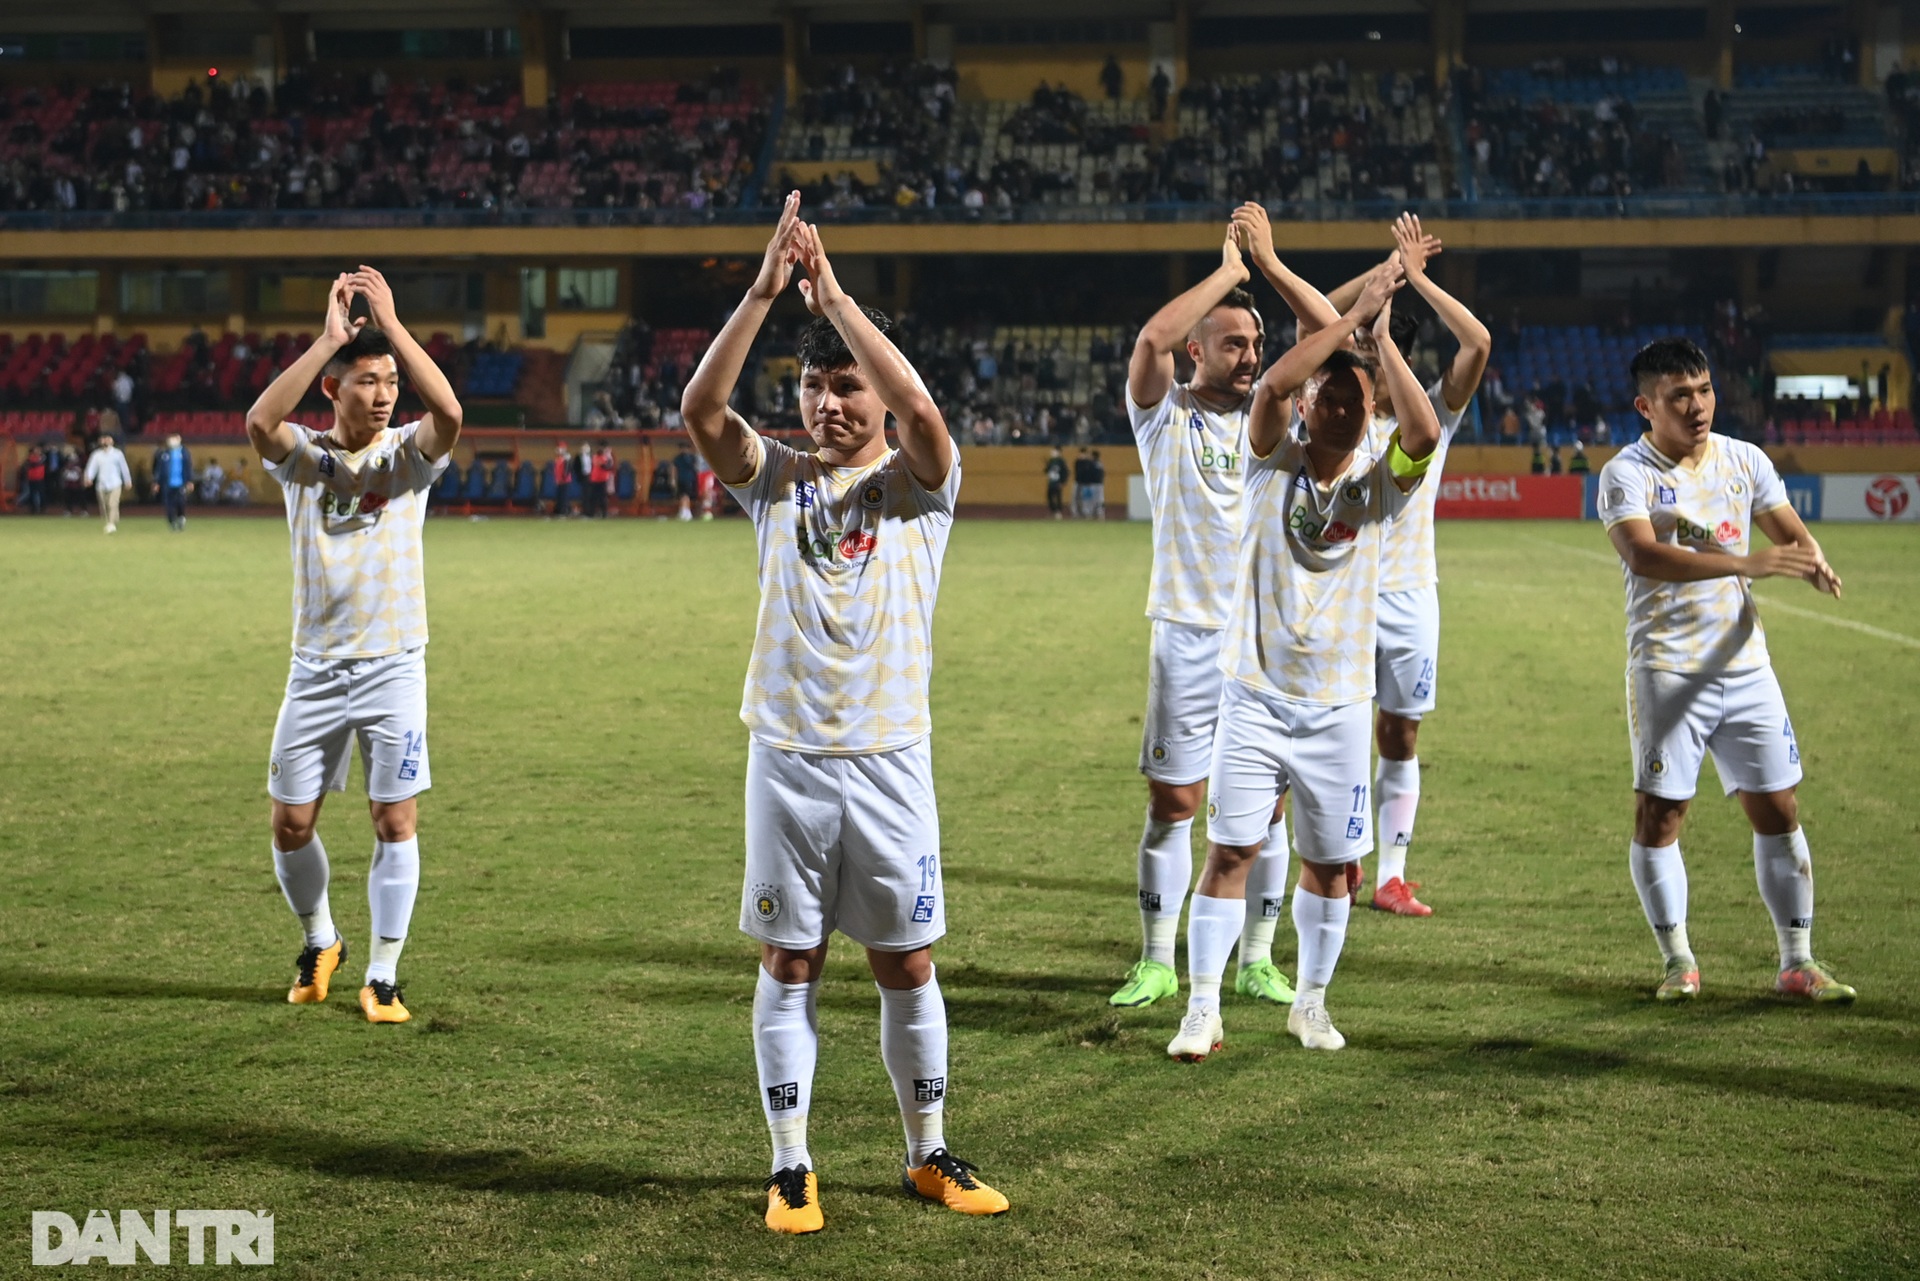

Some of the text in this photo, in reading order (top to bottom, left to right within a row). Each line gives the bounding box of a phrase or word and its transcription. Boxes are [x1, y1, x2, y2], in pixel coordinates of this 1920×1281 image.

[1437, 477, 1521, 501] ettel
[1420, 658, 1434, 681] 16
[404, 730, 422, 757] 14
[1352, 784, 1367, 813] 11
[917, 854, 936, 891] 19
